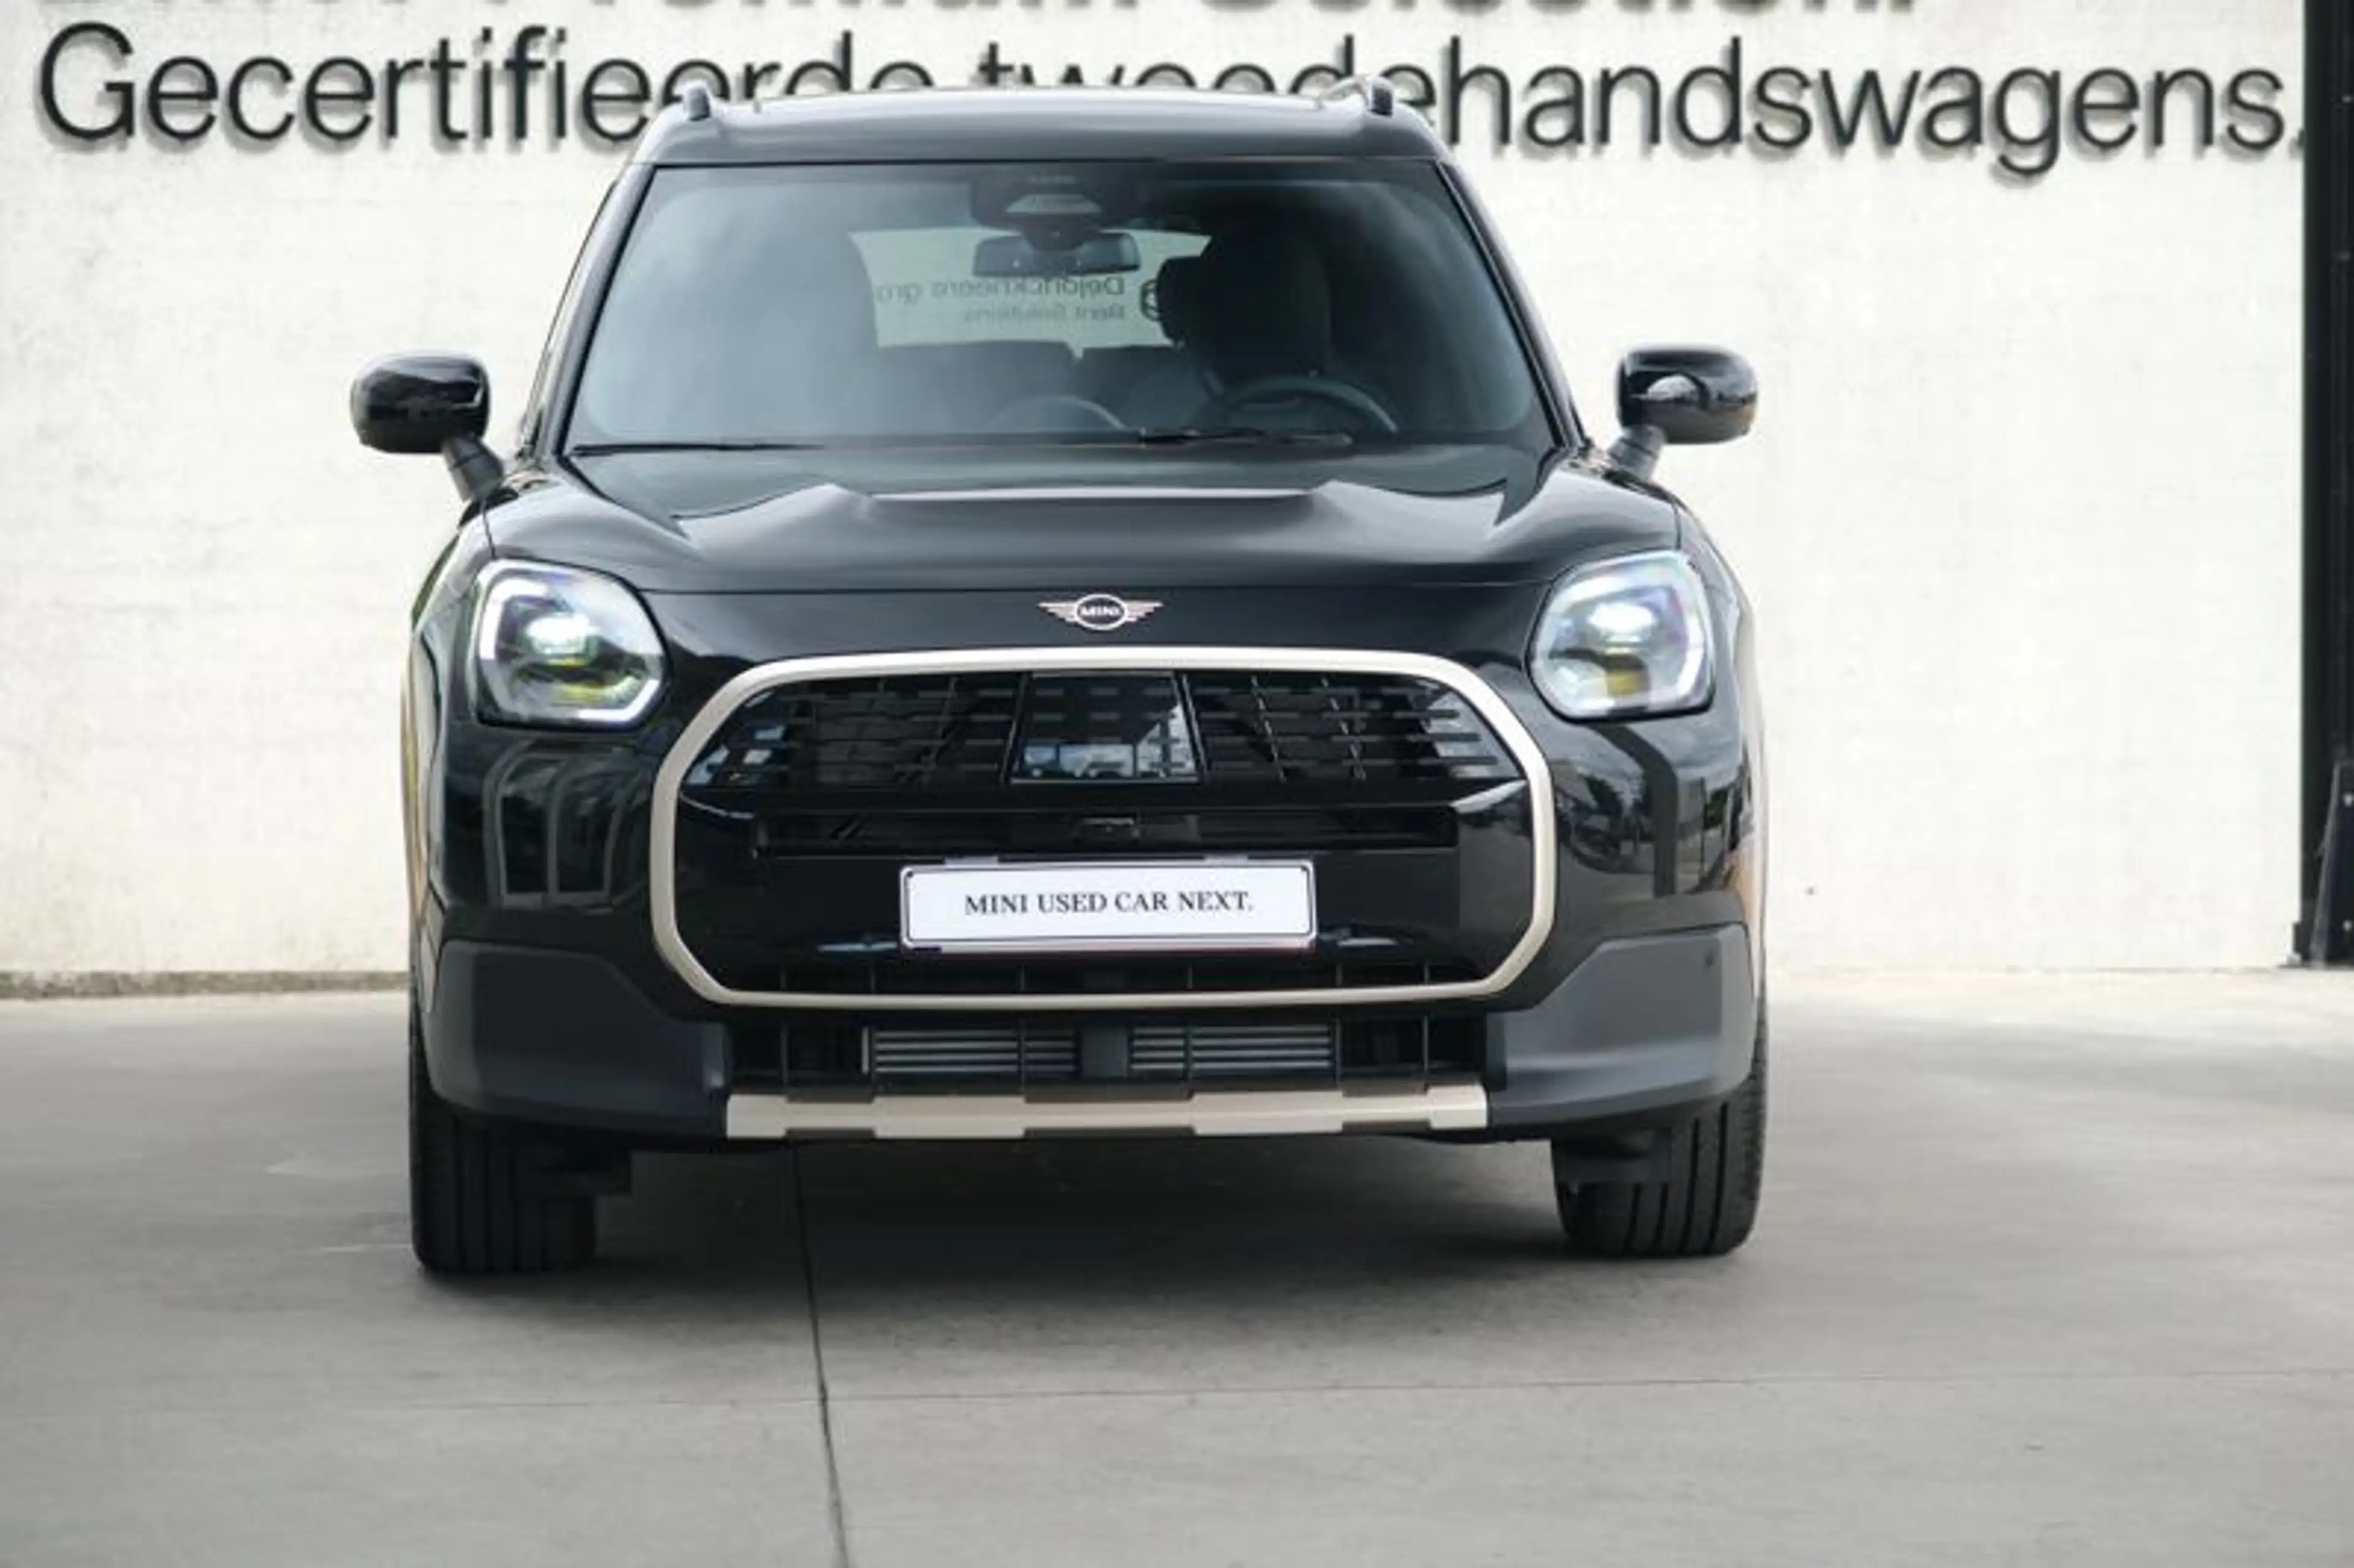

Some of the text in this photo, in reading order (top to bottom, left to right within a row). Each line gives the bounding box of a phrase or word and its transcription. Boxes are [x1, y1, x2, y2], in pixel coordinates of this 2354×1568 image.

[1080, 606, 1121, 616] MINI
[964, 889, 1253, 915] MINI USED CAR NEXT.
